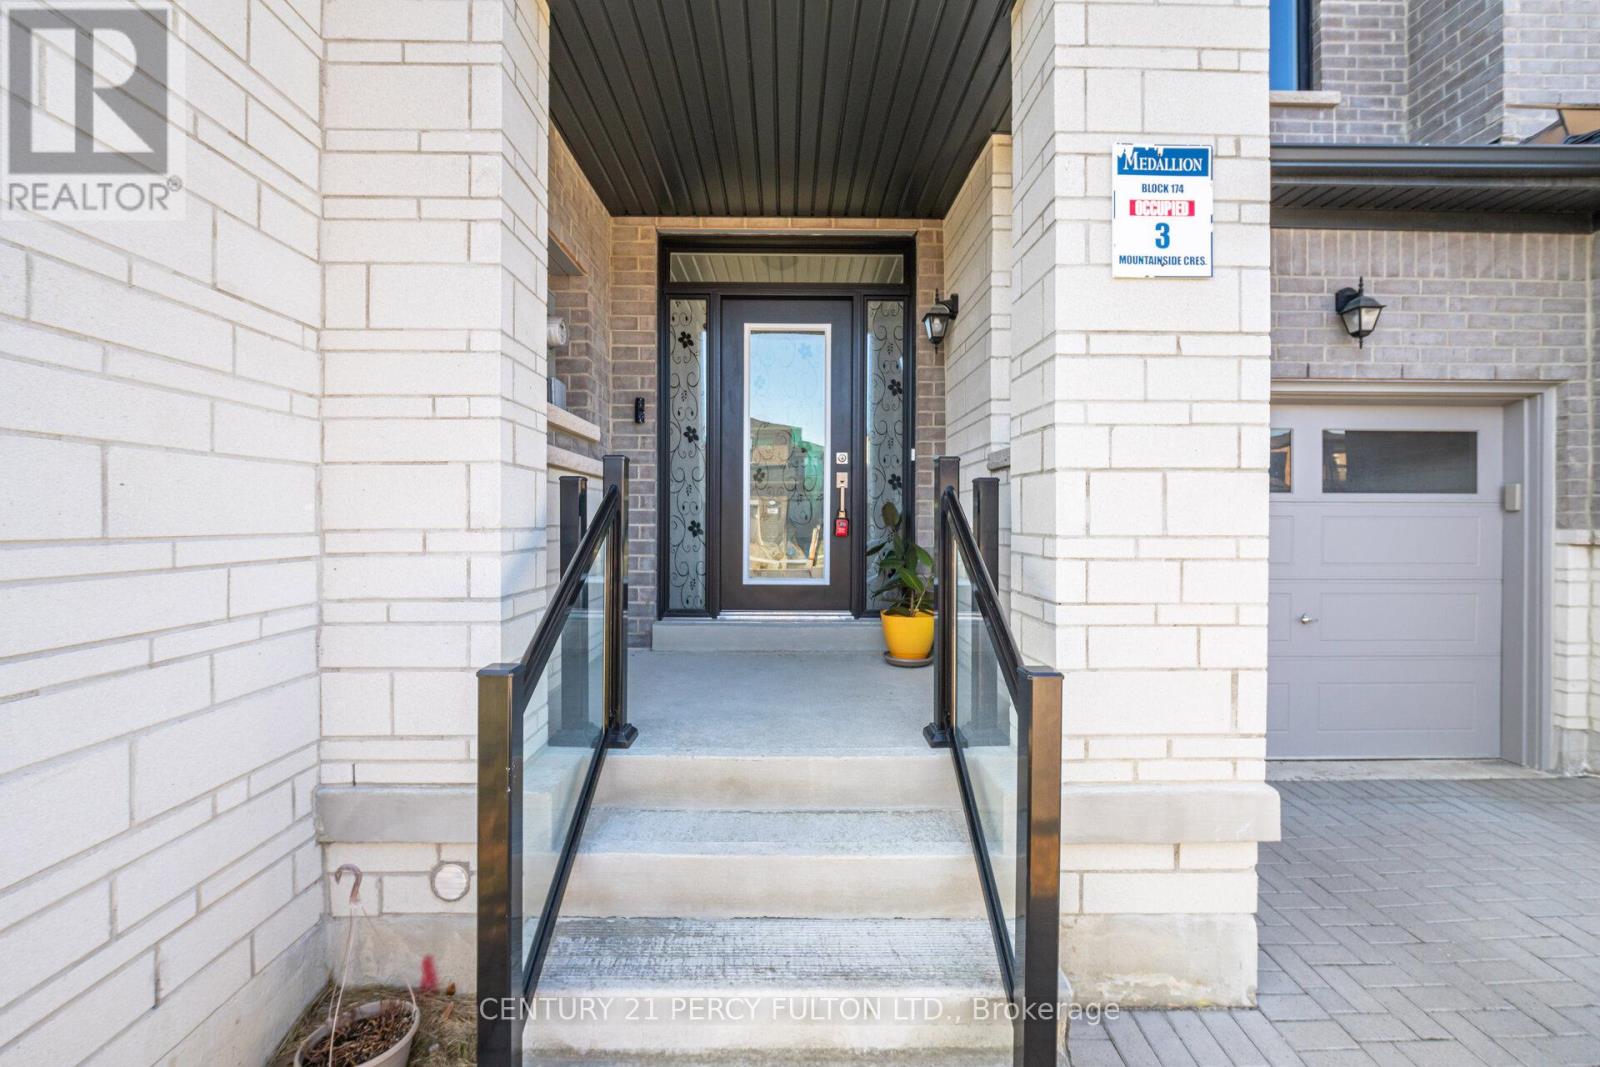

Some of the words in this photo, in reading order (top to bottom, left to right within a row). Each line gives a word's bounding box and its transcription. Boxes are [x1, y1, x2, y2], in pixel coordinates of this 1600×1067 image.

[1123, 151, 1203, 171] MEDALLION
[1141, 183, 1169, 193] BLOCK
[1171, 184, 1184, 193] 174
[1134, 200, 1190, 216] OCCUPIED
[1155, 222, 1170, 249] 3
[1119, 255, 1182, 266] MOUNTAINSIDE
